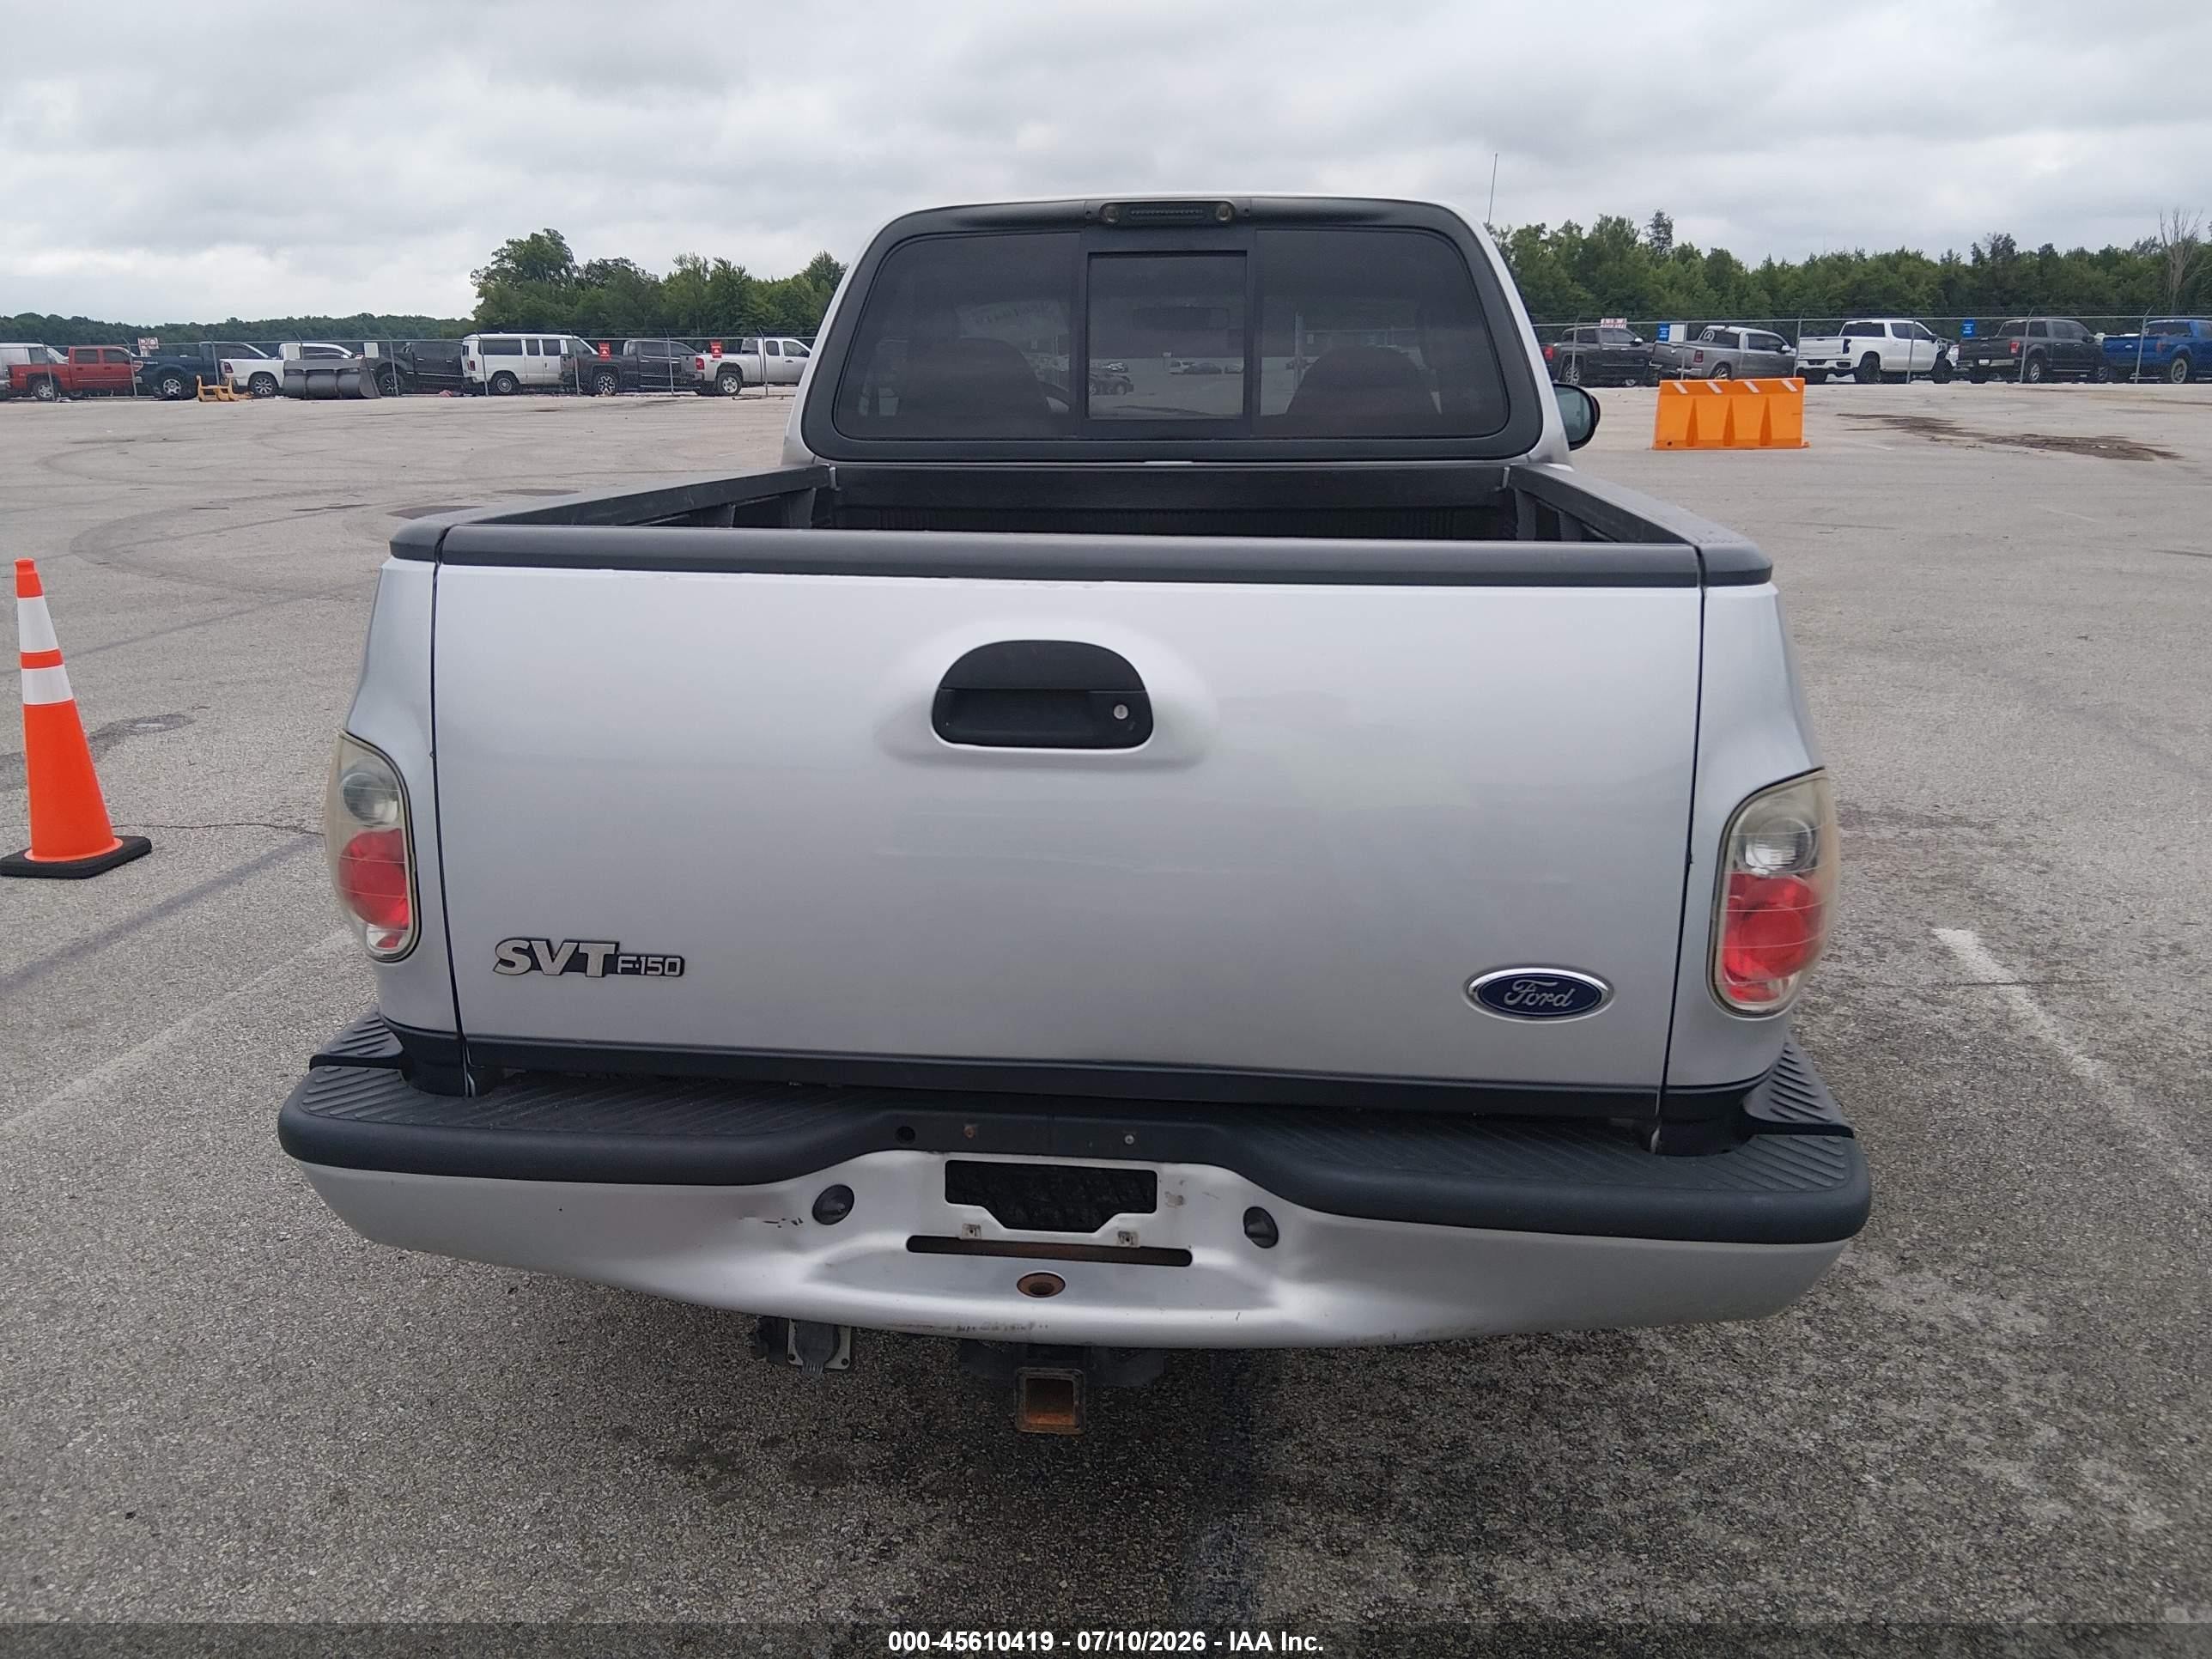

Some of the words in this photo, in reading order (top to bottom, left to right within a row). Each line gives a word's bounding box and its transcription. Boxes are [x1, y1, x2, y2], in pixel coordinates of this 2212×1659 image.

[492, 937, 620, 977] SVT
[617, 956, 684, 977] F-150
[1503, 979, 1577, 1007] Ford
